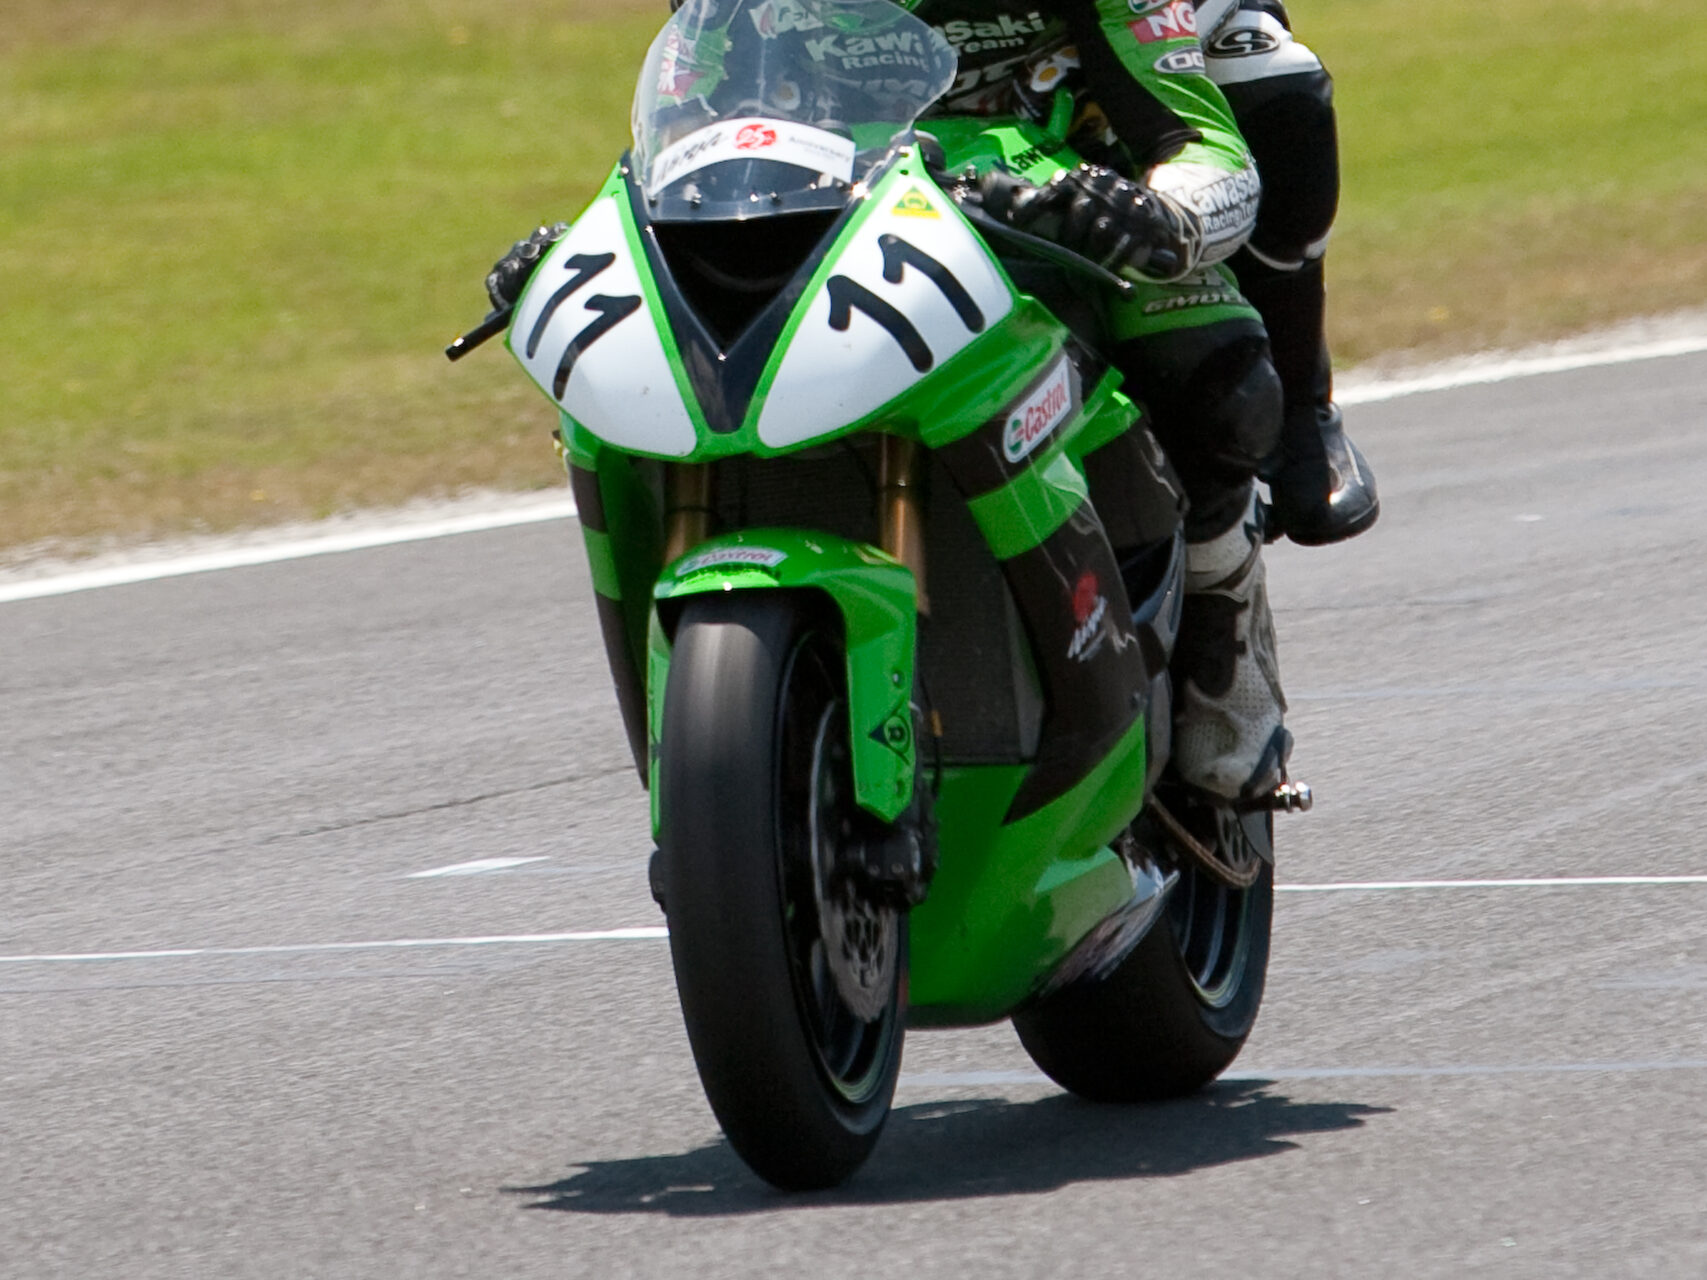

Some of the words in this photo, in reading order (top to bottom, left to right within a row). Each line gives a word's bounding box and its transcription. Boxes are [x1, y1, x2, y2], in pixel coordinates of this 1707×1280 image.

[526, 251, 641, 400] 11
[826, 233, 985, 373] 11
[1024, 372, 1067, 441] Castrol
